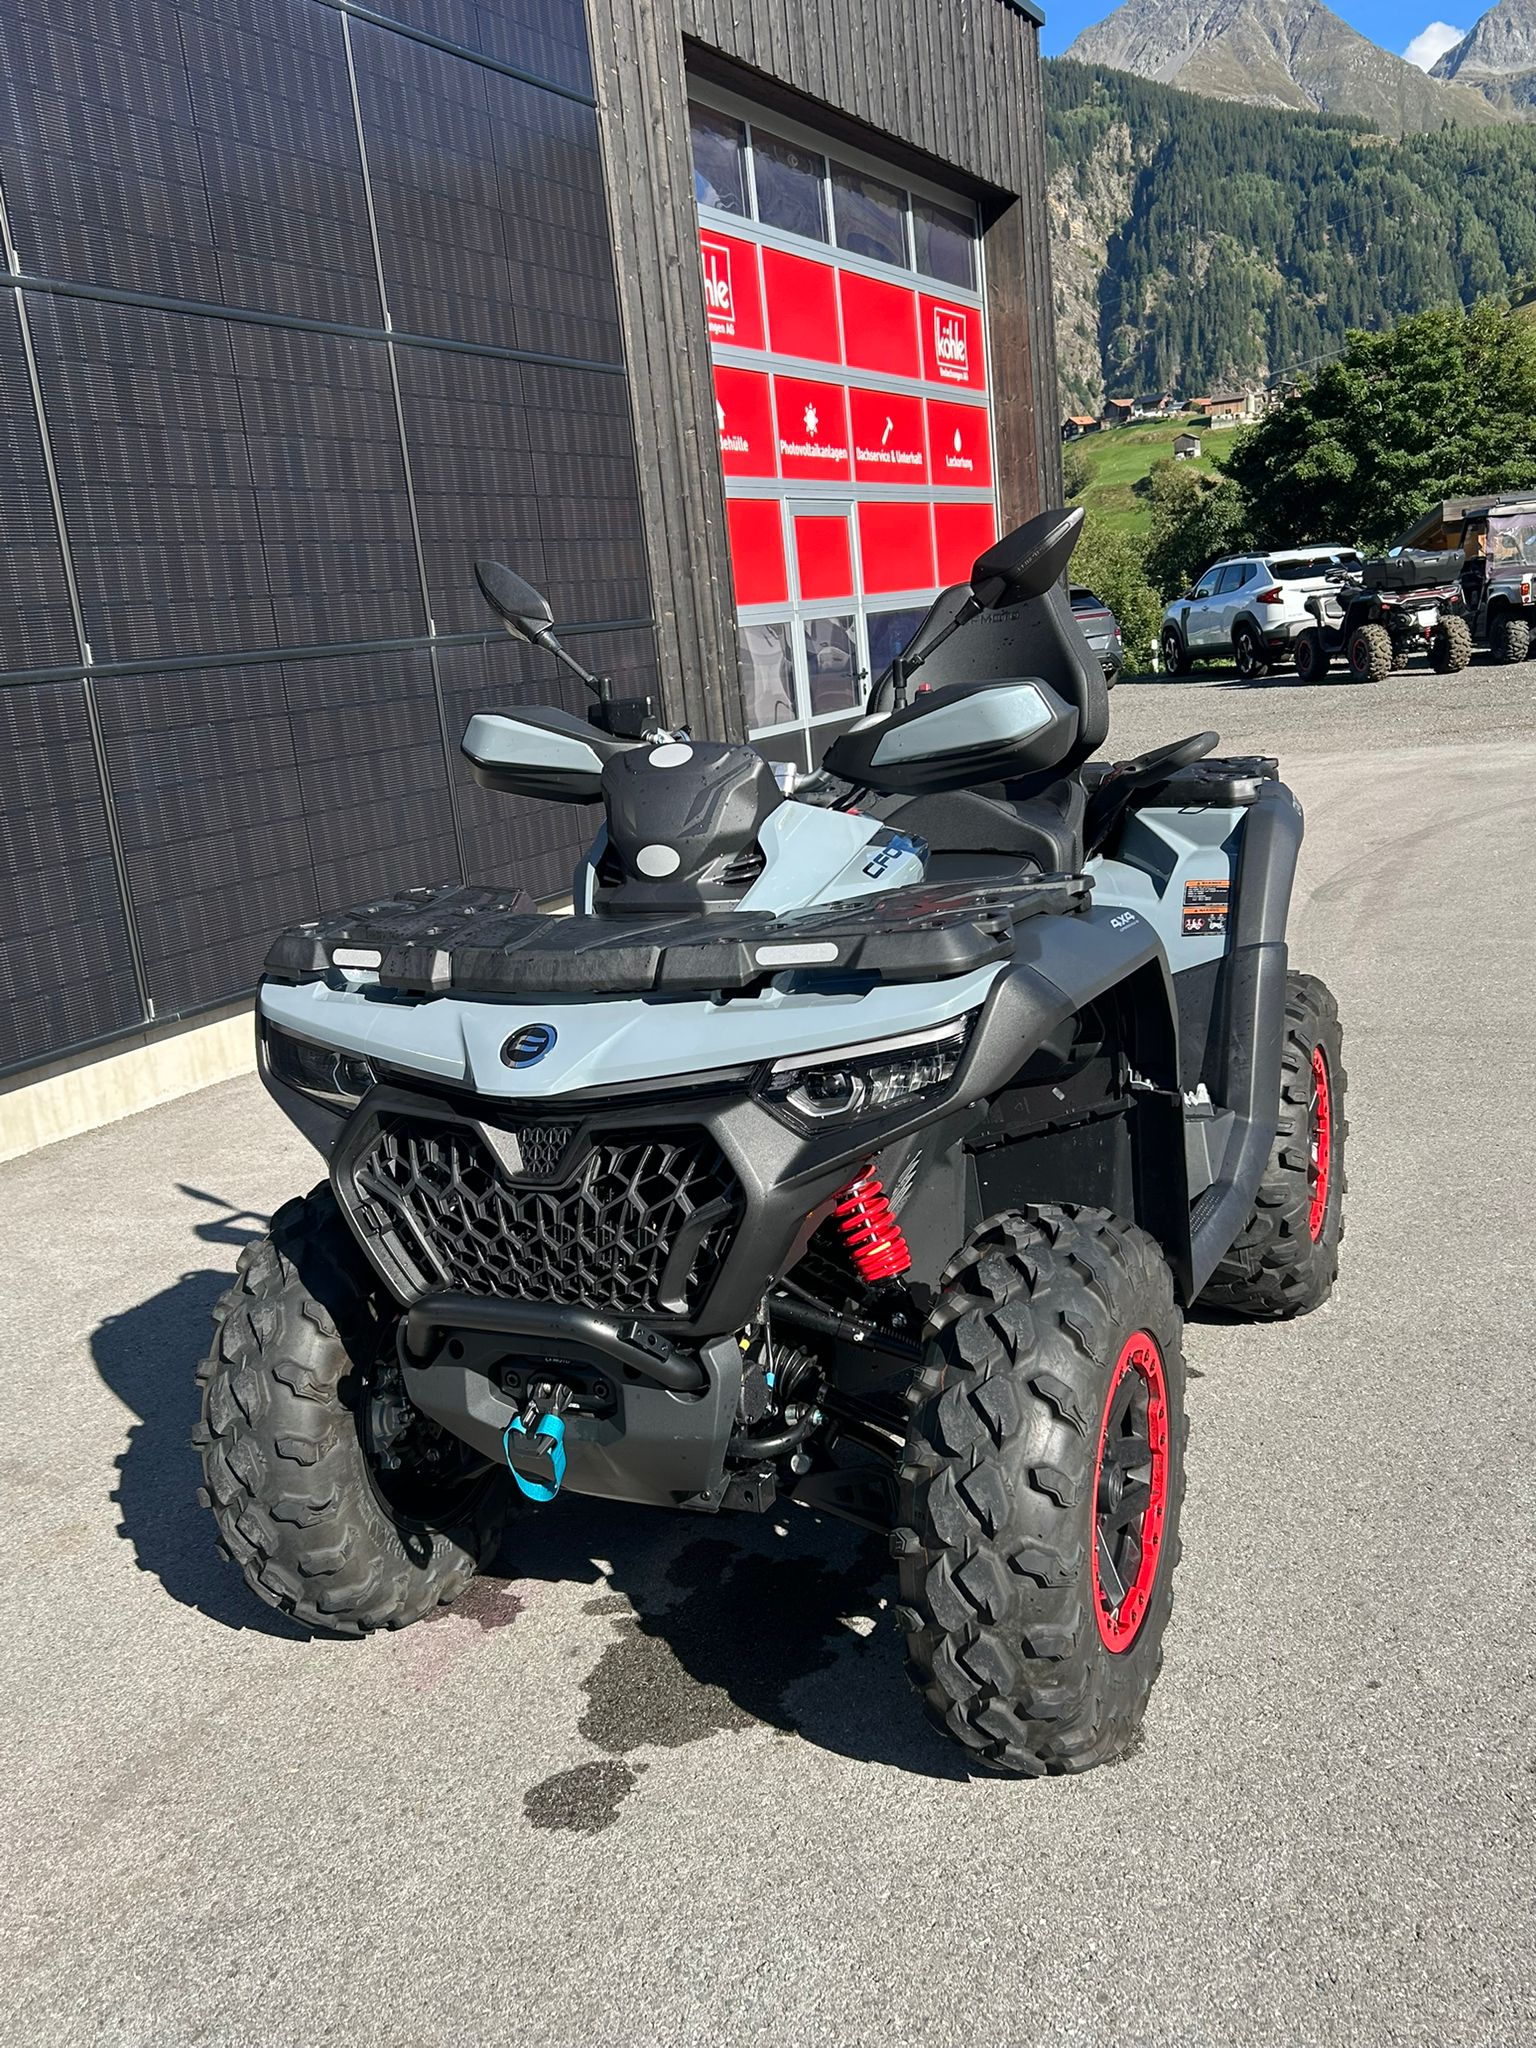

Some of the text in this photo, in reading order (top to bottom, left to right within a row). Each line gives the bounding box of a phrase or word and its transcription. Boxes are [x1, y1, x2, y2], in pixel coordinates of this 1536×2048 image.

[702, 252, 729, 309] hle
[936, 316, 965, 361] köhle
[780, 439, 848, 462] Photovoltaikanlagen
[971, 612, 1020, 625] MOTO
